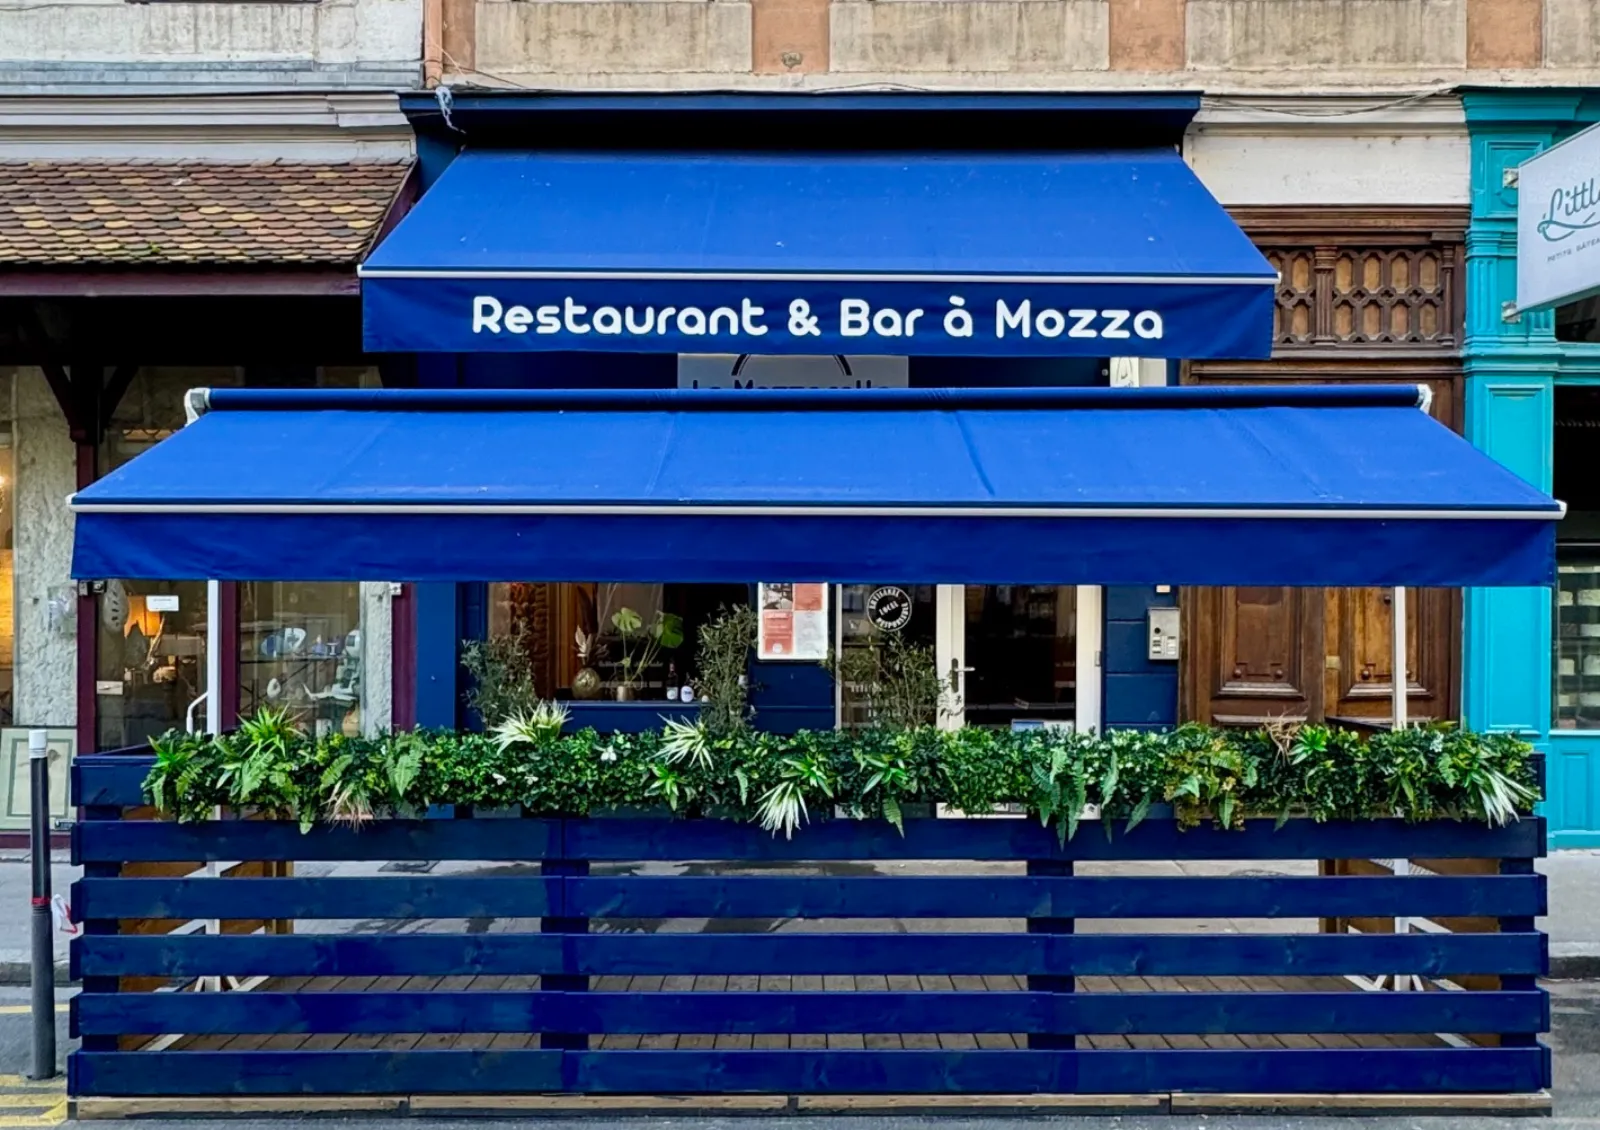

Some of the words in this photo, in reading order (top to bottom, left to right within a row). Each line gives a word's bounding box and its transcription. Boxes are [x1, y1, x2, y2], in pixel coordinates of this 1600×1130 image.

[1537, 178, 1600, 240] Littl
[472, 295, 769, 335] Restaurant
[788, 298, 822, 337] &
[840, 298, 924, 337] Bar
[943, 295, 973, 337] à
[996, 299, 1163, 339] Mozza
